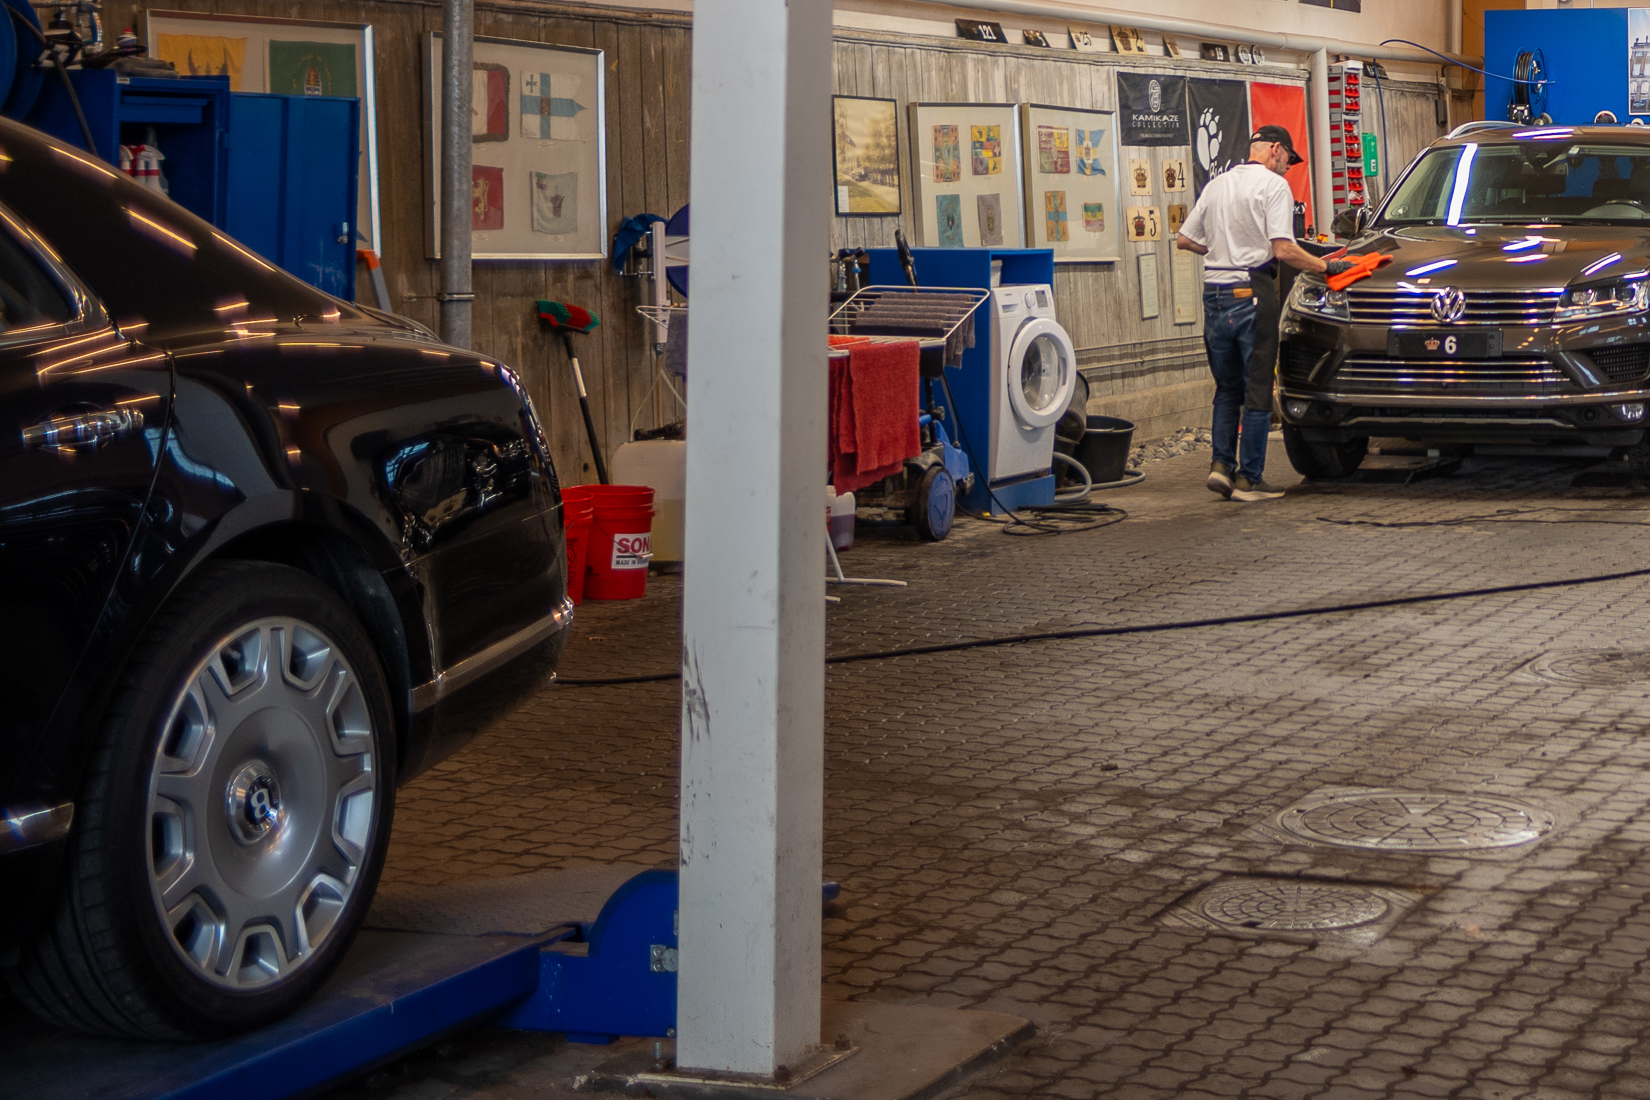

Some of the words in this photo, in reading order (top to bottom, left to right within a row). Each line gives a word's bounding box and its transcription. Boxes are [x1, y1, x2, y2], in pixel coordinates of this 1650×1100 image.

[978, 24, 998, 40] 121
[1132, 114, 1179, 122] KAMIKAZE
[1177, 162, 1186, 188] 4
[1148, 209, 1157, 237] 5
[1445, 335, 1457, 354] 6
[617, 537, 651, 554] SON
[250, 788, 271, 819] B
